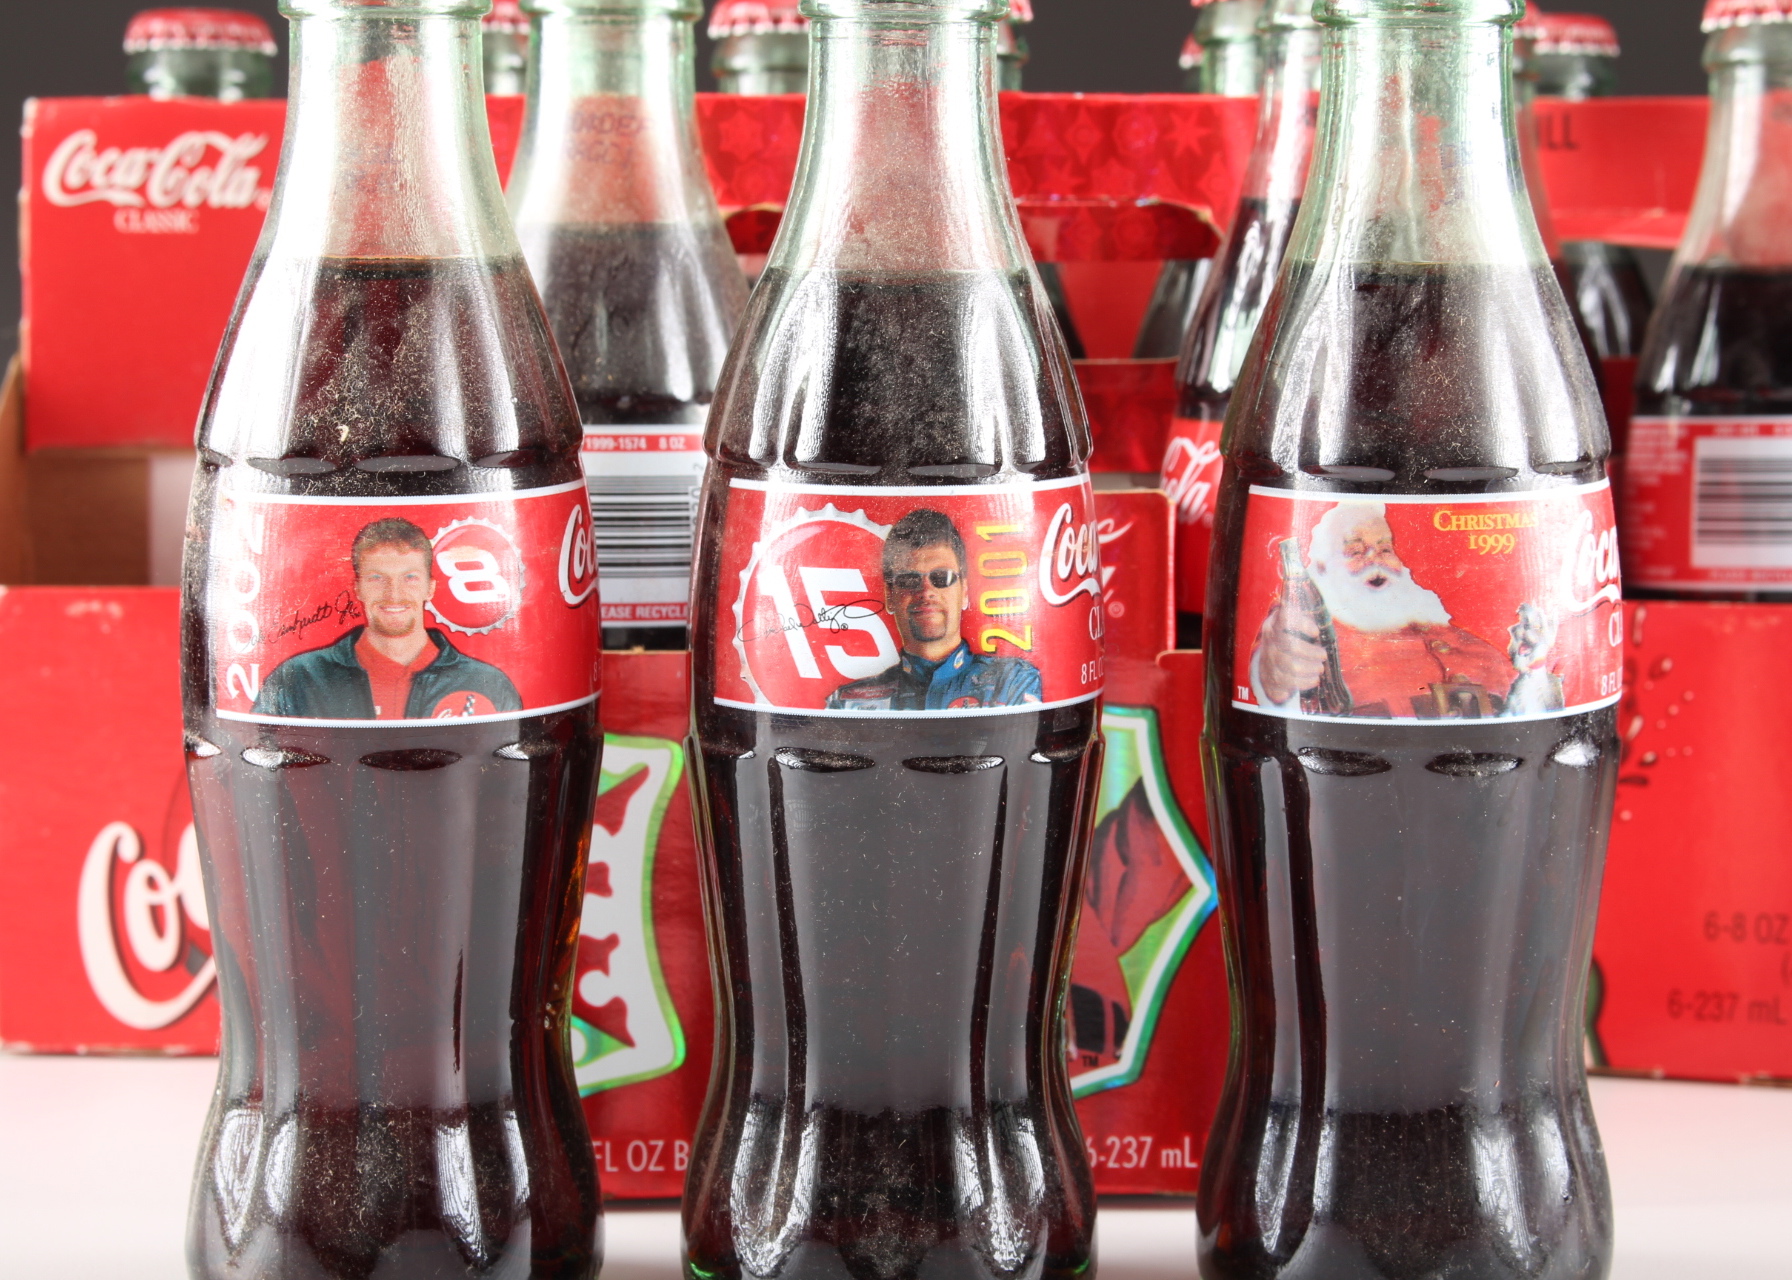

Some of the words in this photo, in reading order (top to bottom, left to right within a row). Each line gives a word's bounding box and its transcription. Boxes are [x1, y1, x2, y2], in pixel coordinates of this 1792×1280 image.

[42, 129, 269, 209] Coca-Cola
[114, 208, 200, 234] CLASSIC
[1468, 533, 1516, 555] 1999
[436, 546, 510, 604] 8
[975, 522, 1033, 653] 2001
[757, 564, 901, 680] 15
[1237, 685, 1249, 700] TM
[1702, 910, 1748, 943] 6-8
[1666, 988, 1740, 1022] 6-237
[1747, 994, 1788, 1025] mL
[626, 1139, 665, 1172] OZ
[1161, 1135, 1198, 1168] mL
